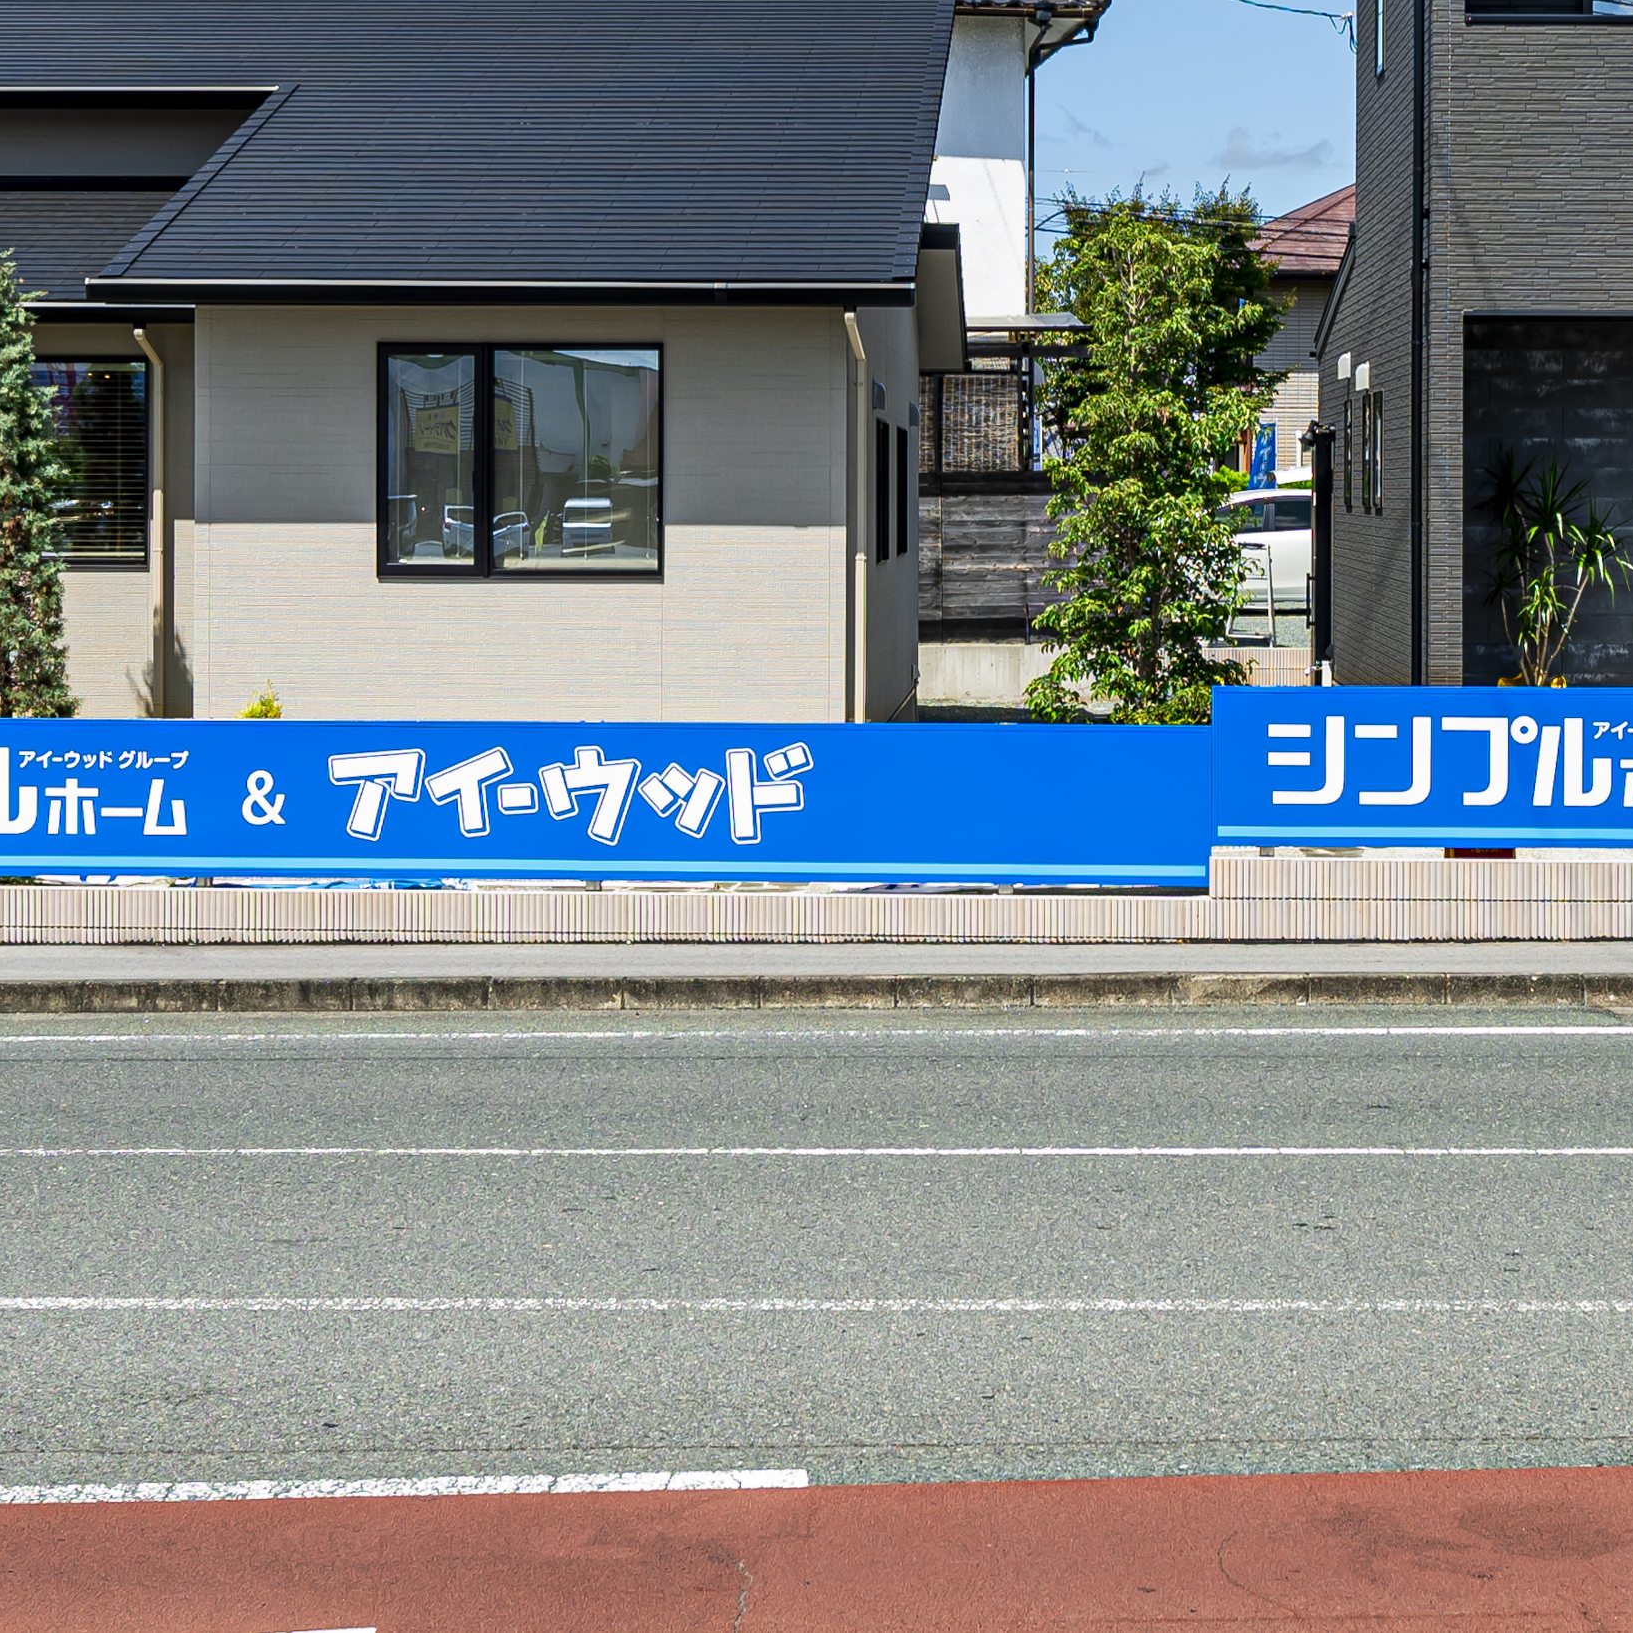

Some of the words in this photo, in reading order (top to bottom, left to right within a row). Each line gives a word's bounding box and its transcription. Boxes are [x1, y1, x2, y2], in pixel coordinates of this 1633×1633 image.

[118, 750, 189, 770] グループ
[241, 769, 286, 826] &
